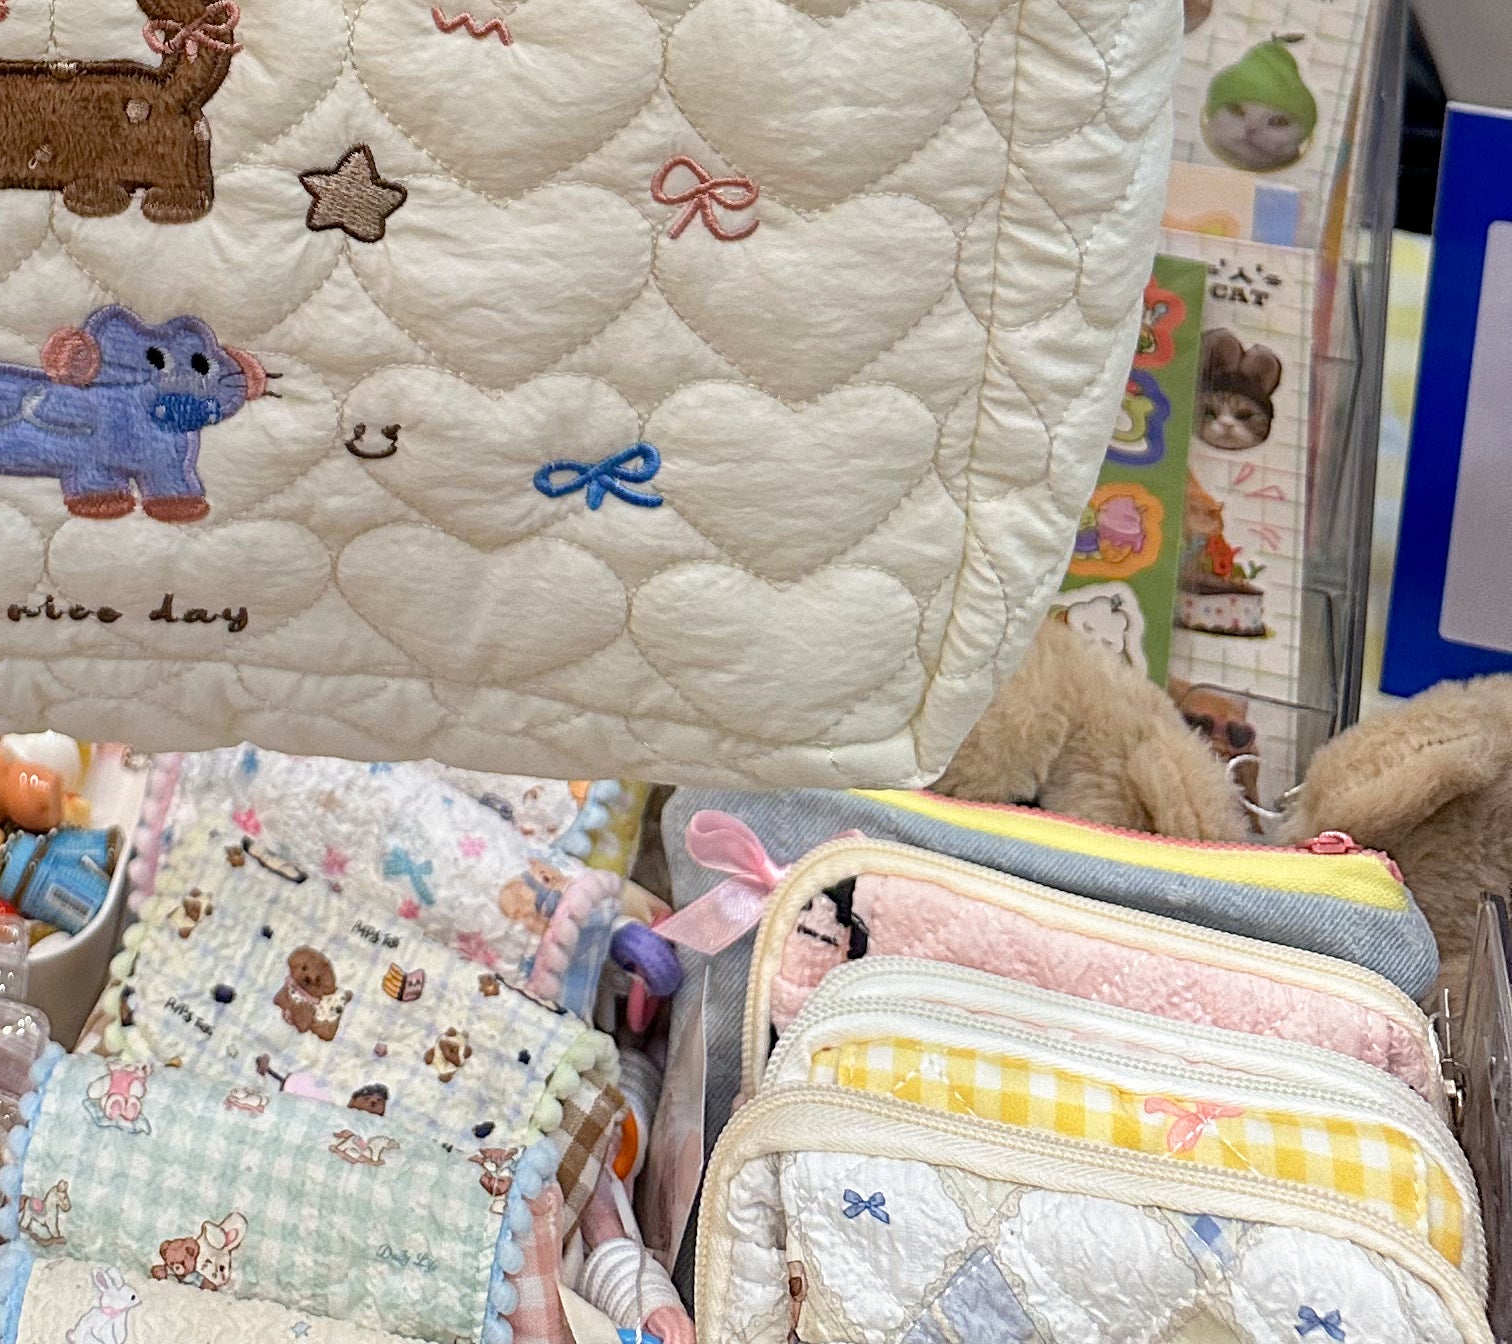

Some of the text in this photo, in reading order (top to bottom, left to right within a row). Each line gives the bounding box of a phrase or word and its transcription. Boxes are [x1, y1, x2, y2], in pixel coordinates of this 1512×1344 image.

[1209, 282, 1270, 308] CAT
[5, 594, 124, 623] nice
[148, 592, 250, 633] day
